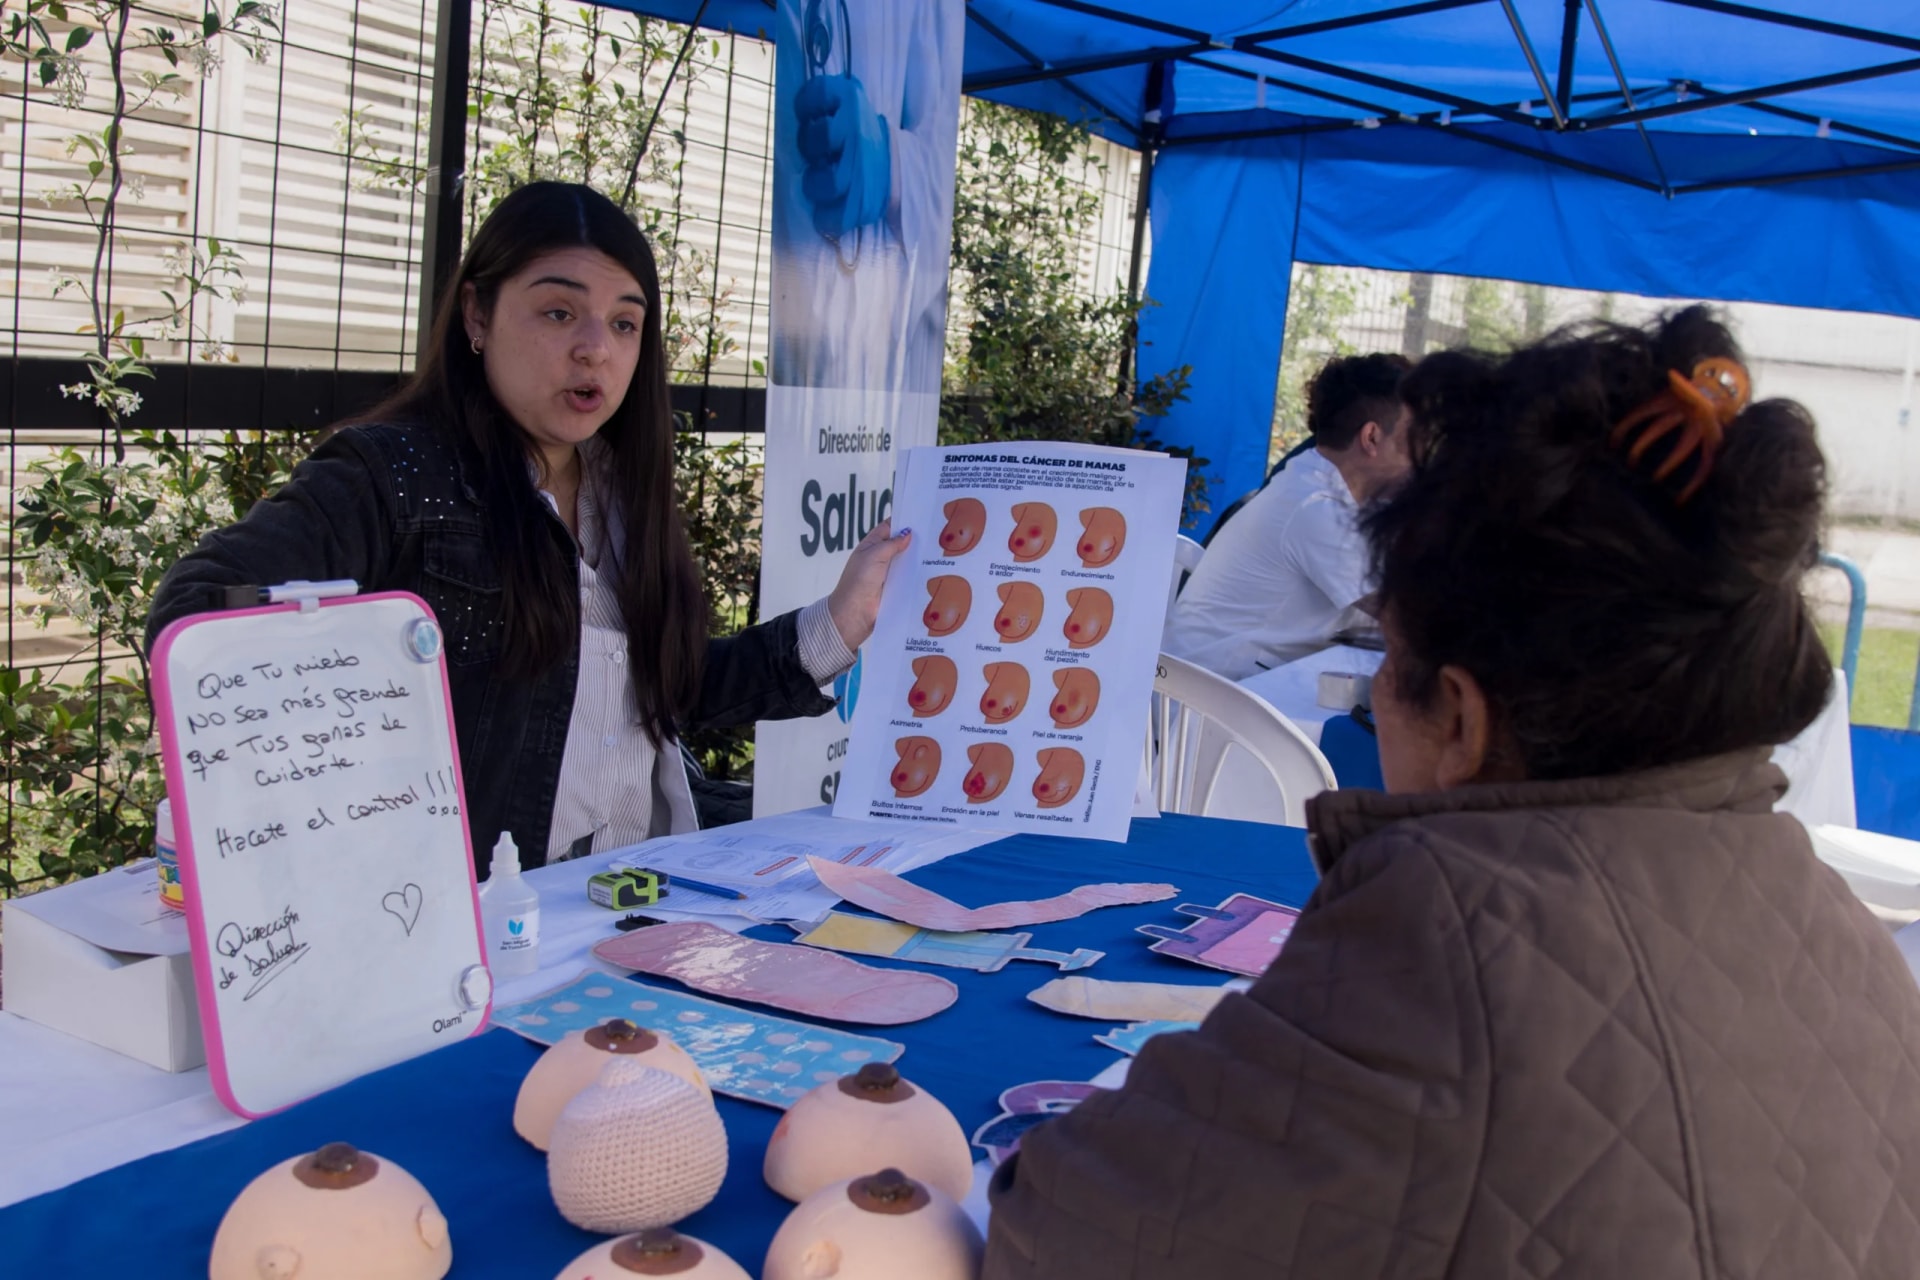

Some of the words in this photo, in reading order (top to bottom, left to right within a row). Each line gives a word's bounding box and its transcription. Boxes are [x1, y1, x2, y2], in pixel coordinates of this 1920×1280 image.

[819, 425, 875, 454] Dirección
[876, 427, 892, 453] de
[944, 454, 998, 463] SINTOMAS
[999, 455, 1020, 464] DEL
[1022, 456, 1066, 467] CÁNCER
[1068, 459, 1083, 468] DE
[1085, 461, 1126, 471] MAMAS
[1089, 472, 1117, 481] maligno
[990, 563, 1041, 574] Enrojecimiento
[1060, 569, 1115, 580] Endurecimiento
[906, 637, 932, 647] Líquido
[975, 644, 1002, 652] Huecos
[905, 645, 945, 654] secreciones
[1045, 649, 1090, 659] Hundimiento
[1044, 654, 1055, 662] del
[1056, 656, 1079, 665] pezón
[198, 672, 248, 700] Que
[281, 685, 326, 714] más
[333, 679, 410, 718] grande
[1032, 730, 1046, 739] Piel
[1046, 731, 1056, 740] de
[1057, 733, 1083, 742] naranja
[187, 748, 231, 782] que
[302, 721, 366, 758] ganas
[381, 712, 407, 732] de
[871, 800, 894, 809] Bultos
[895, 802, 923, 811] internos
[941, 806, 968, 816] Erosión
[987, 809, 1000, 818] piel
[1014, 811, 1035, 820] Venas
[1036, 813, 1074, 823] resaltadas
[307, 807, 335, 831] el
[216, 904, 300, 958] Dirección
[219, 966, 239, 990] de
